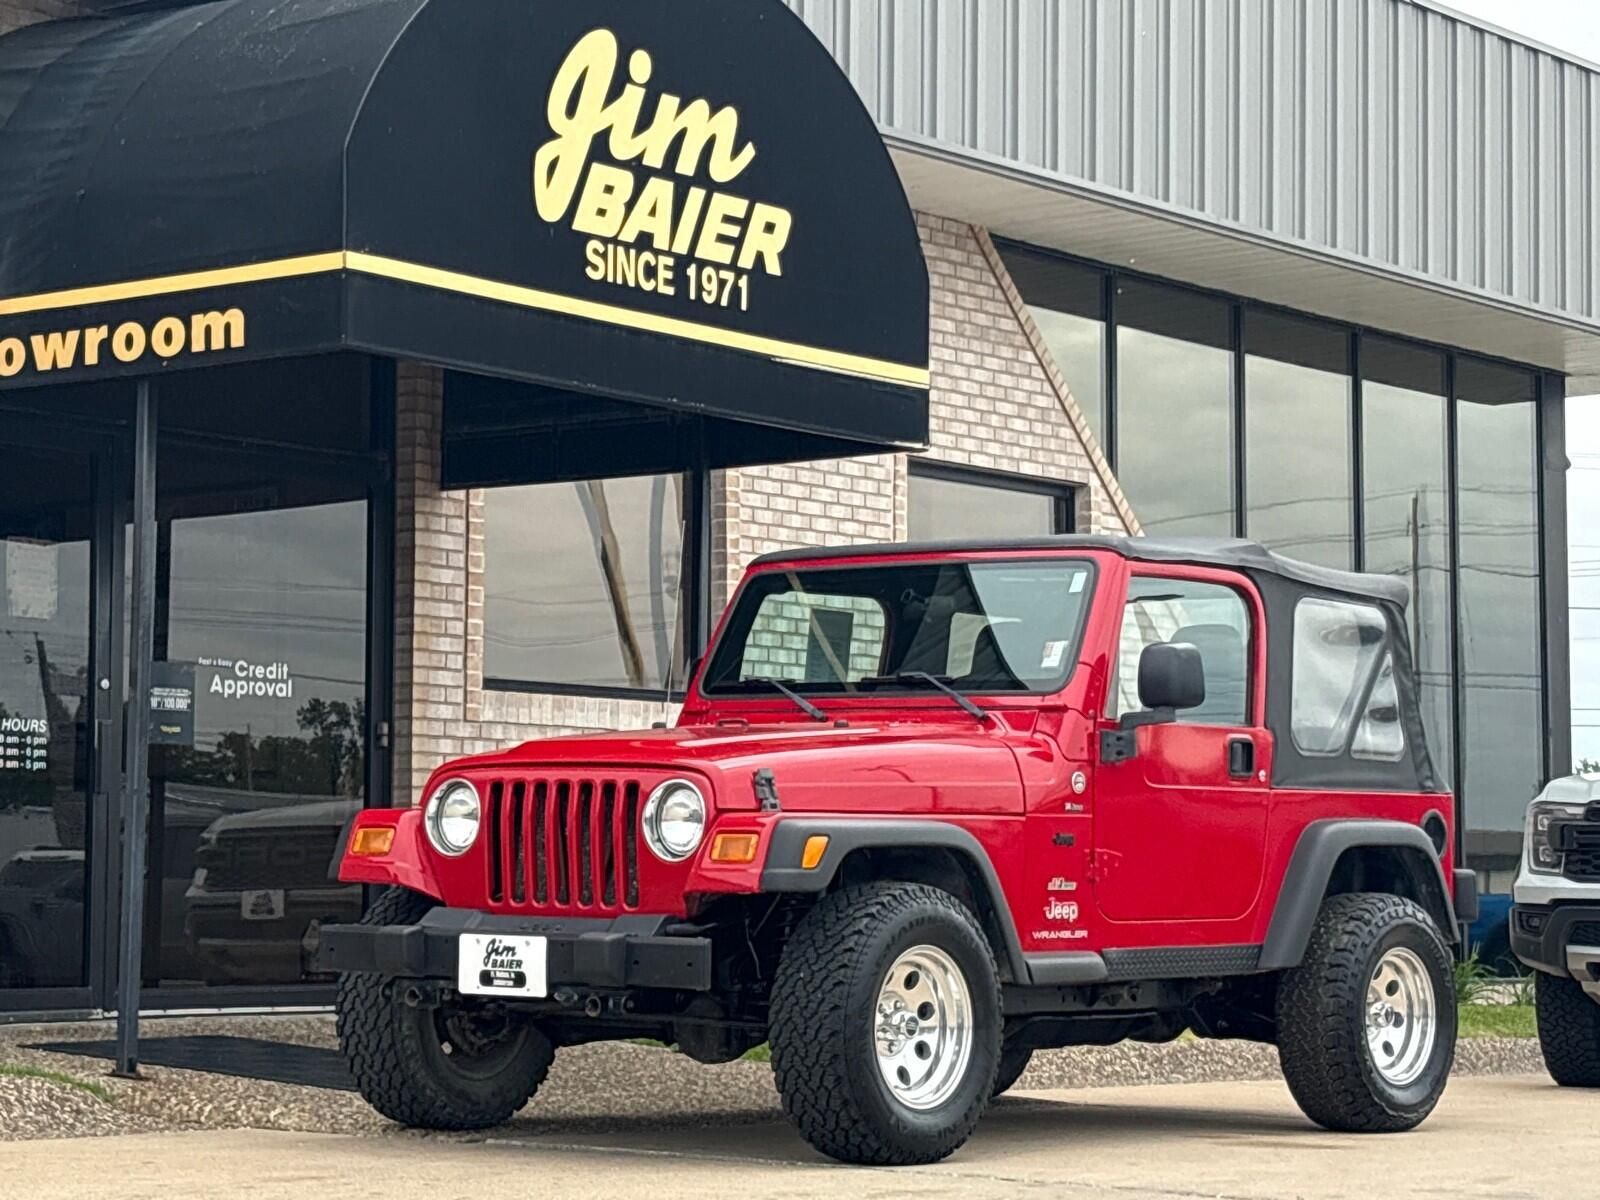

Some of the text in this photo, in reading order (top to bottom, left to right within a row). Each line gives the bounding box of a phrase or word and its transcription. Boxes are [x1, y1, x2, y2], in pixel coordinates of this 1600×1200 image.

[534, 28, 756, 223] Jim
[571, 162, 792, 276] BAIER
[585, 239, 749, 312] SINCE 1971
[0, 307, 245, 377] owroom
[235, 660, 289, 680] Credit
[210, 674, 292, 699] Approval
[1, 718, 47, 732] HOURS
[6, 736, 20, 744] am
[26, 735, 32, 745] 6
[33, 737, 47, 746] pm
[6, 748, 20, 756] am
[26, 747, 32, 757] 6
[33, 749, 47, 758] pm
[6, 760, 20, 768] am
[26, 759, 32, 769] 5
[33, 761, 47, 770] pm
[1043, 897, 1078, 923] Jeep
[1032, 930, 1088, 939] WRANGLER
[483, 937, 517, 968] Jim
[491, 959, 523, 969] BAIER
